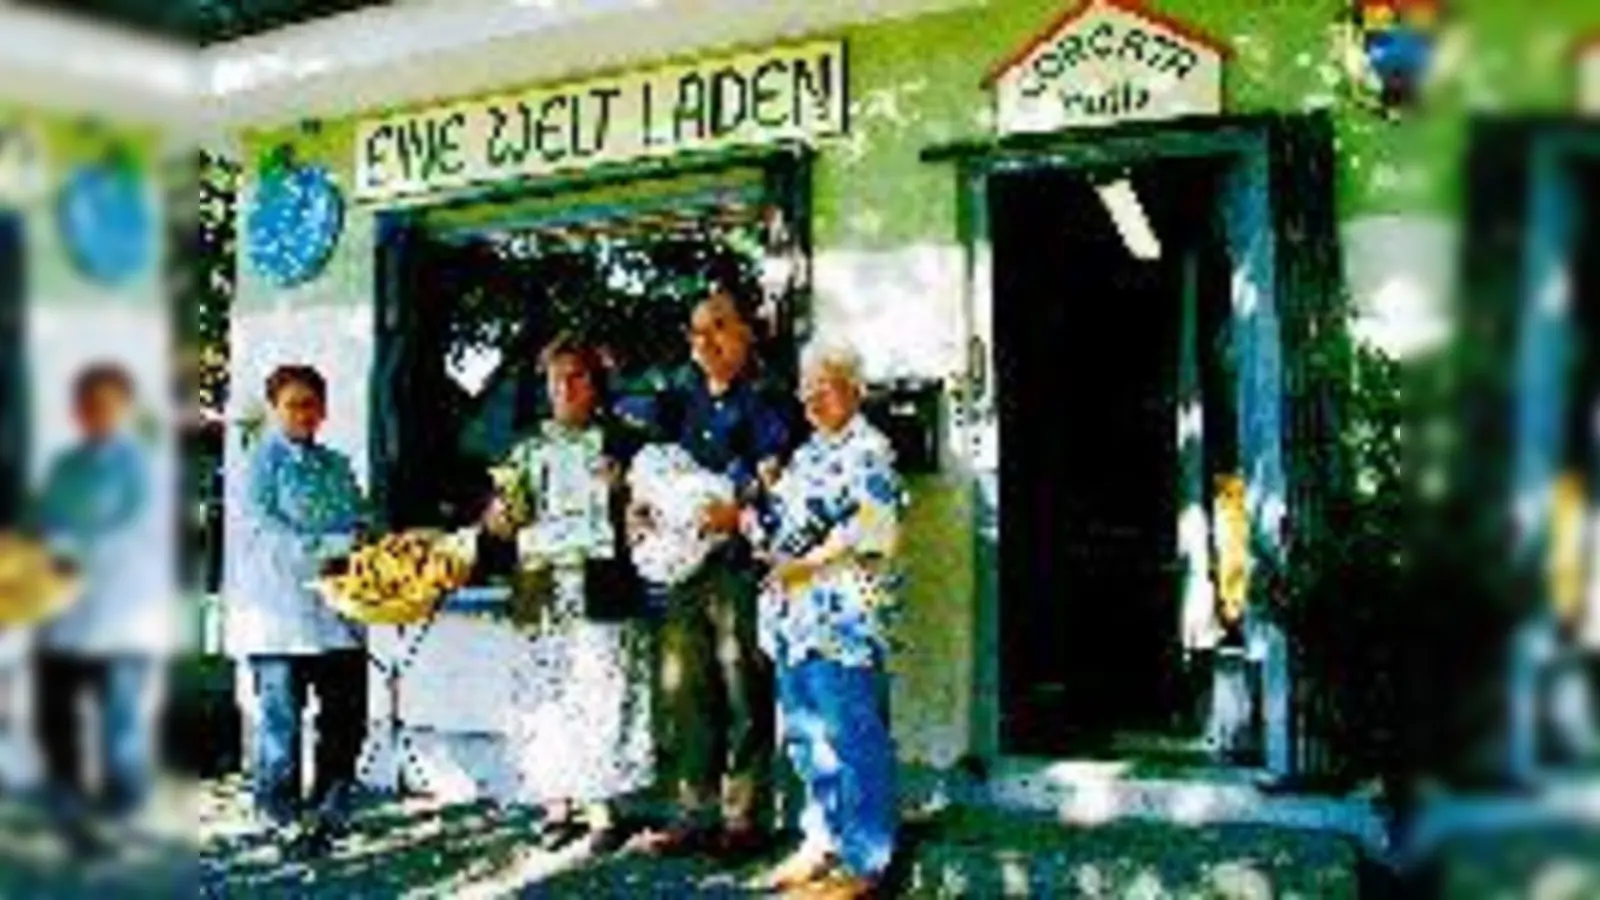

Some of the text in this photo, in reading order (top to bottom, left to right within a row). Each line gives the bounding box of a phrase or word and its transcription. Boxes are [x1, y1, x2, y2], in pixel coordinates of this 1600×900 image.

[366, 53, 832, 187] EINE WELT LADEN
